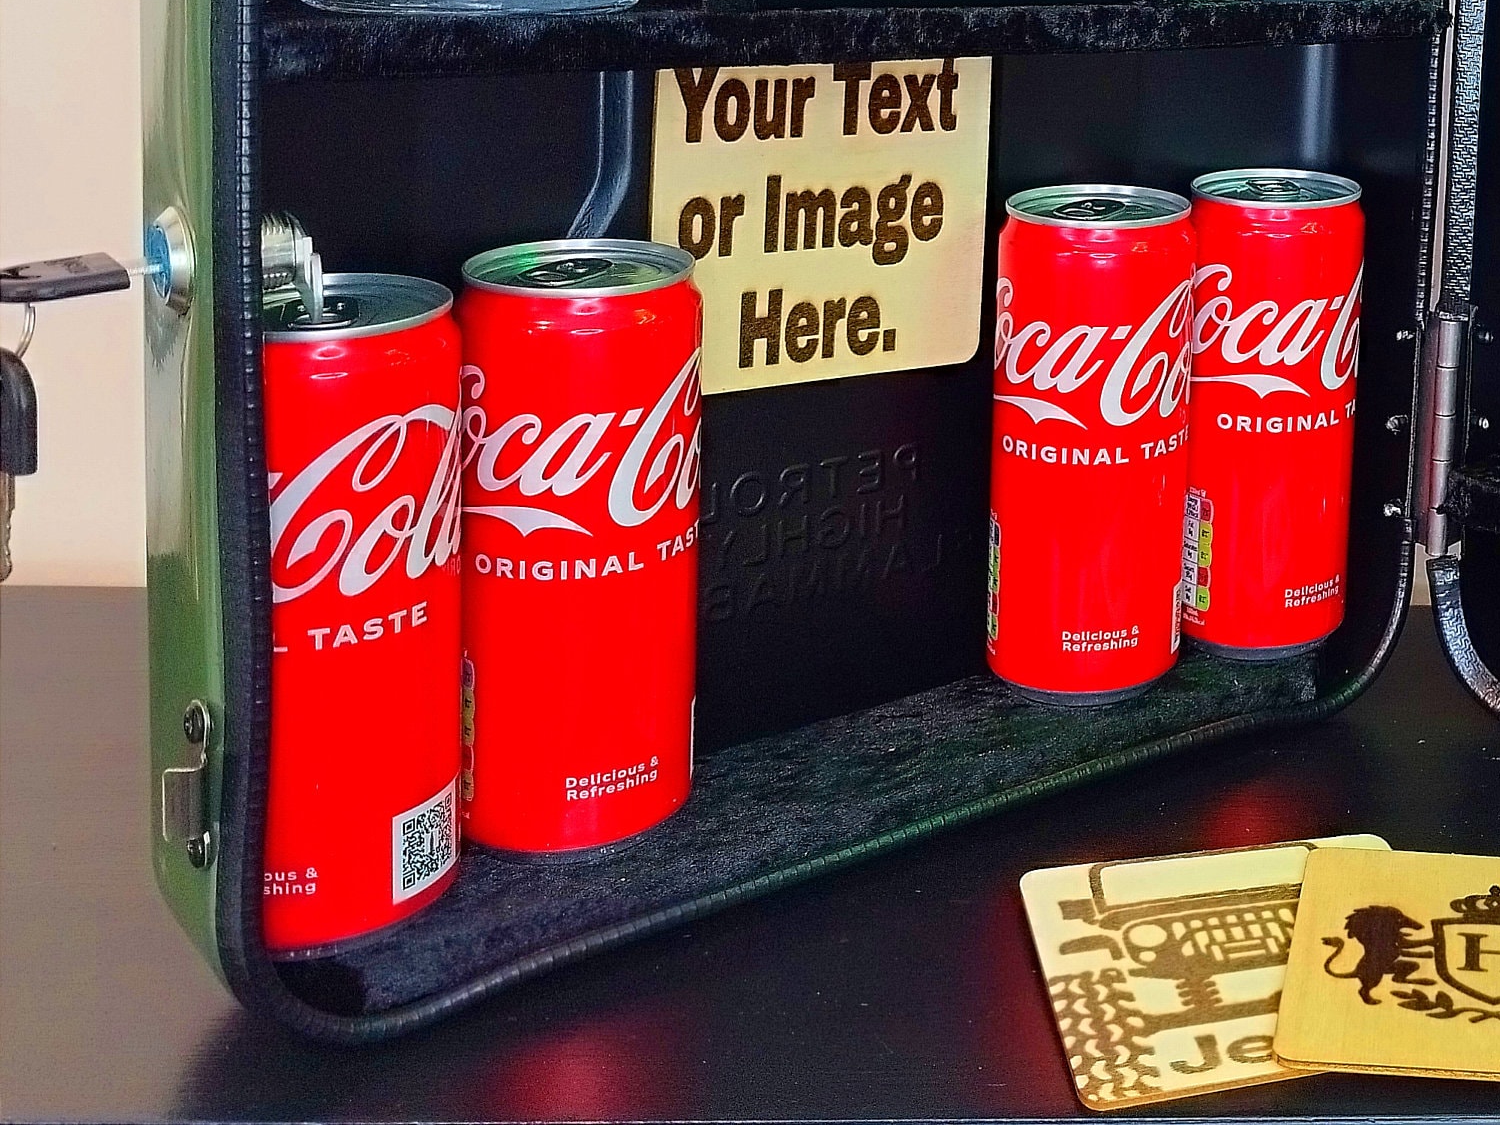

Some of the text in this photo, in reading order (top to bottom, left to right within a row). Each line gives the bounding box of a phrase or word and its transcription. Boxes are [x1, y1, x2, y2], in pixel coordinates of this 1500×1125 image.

[673, 58, 960, 144] Your Text
[678, 174, 945, 266] or Image
[738, 287, 898, 369] Here.
[1216, 410, 1340, 434] ORIGINAL
[1002, 434, 1130, 466] ORIGINAL
[475, 518, 701, 582] ORIGINAL TAST
[1284, 578, 1334, 599] Delicious
[1284, 585, 1339, 608] Refreshing
[307, 601, 428, 651] TASTE
[1062, 625, 1140, 643] Delicious &
[1062, 637, 1138, 652] Refreshing
[565, 755, 660, 789] Delicious &
[566, 769, 658, 802] Refreshing
[305, 866, 319, 879] &
[263, 882, 317, 896] shing
[1168, 1034, 1276, 1075] Je
